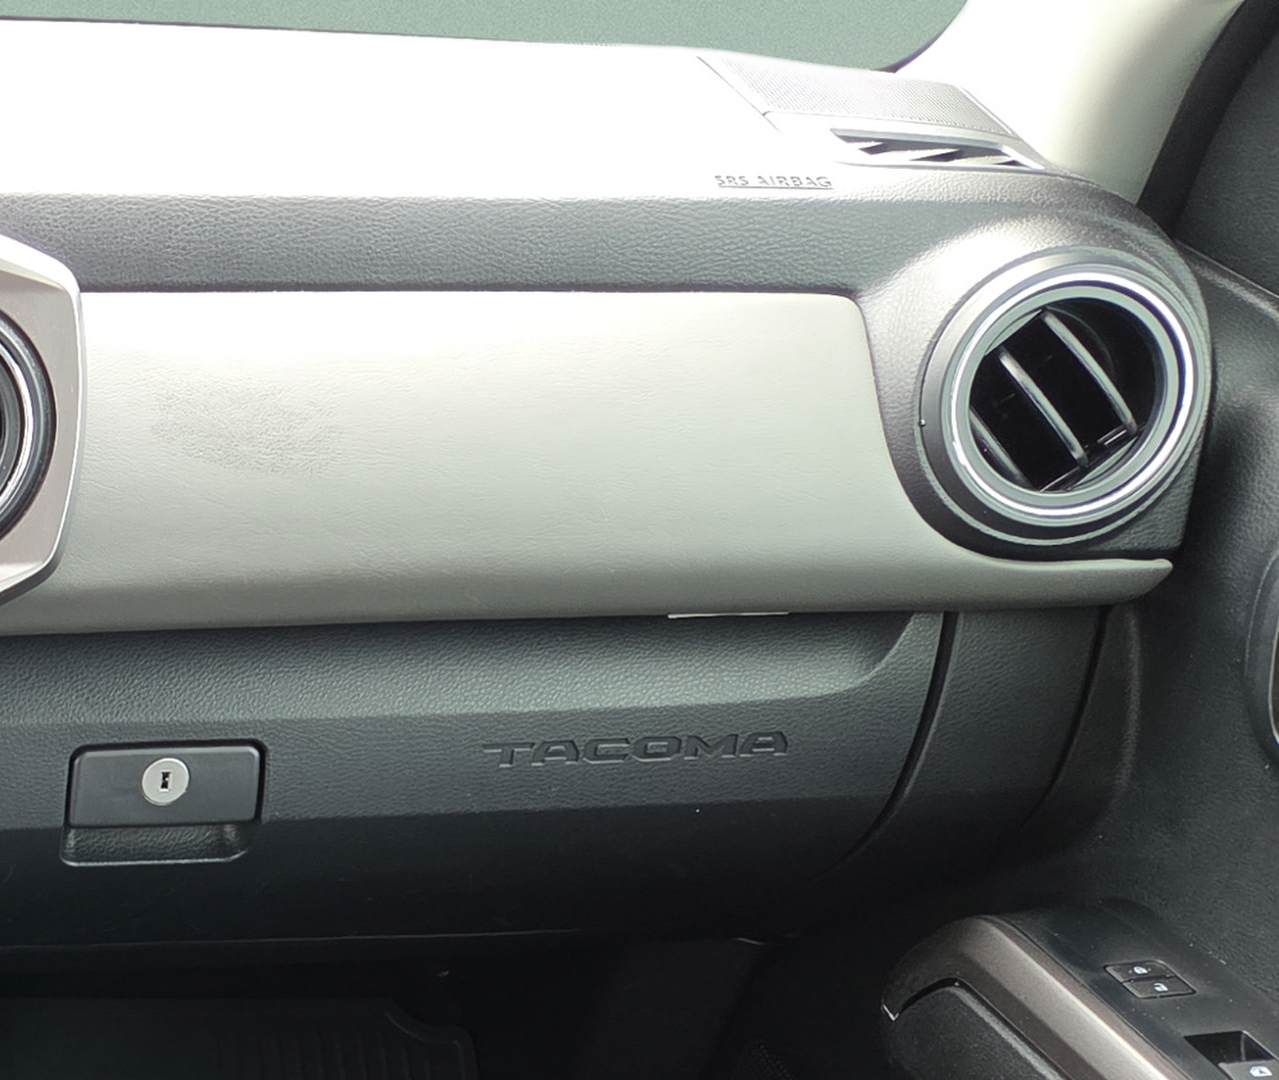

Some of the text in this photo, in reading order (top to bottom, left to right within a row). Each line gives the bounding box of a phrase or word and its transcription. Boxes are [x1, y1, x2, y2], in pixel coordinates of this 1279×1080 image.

[715, 175, 832, 187] SRS AIRBAG
[482, 731, 789, 768] TACOMA
